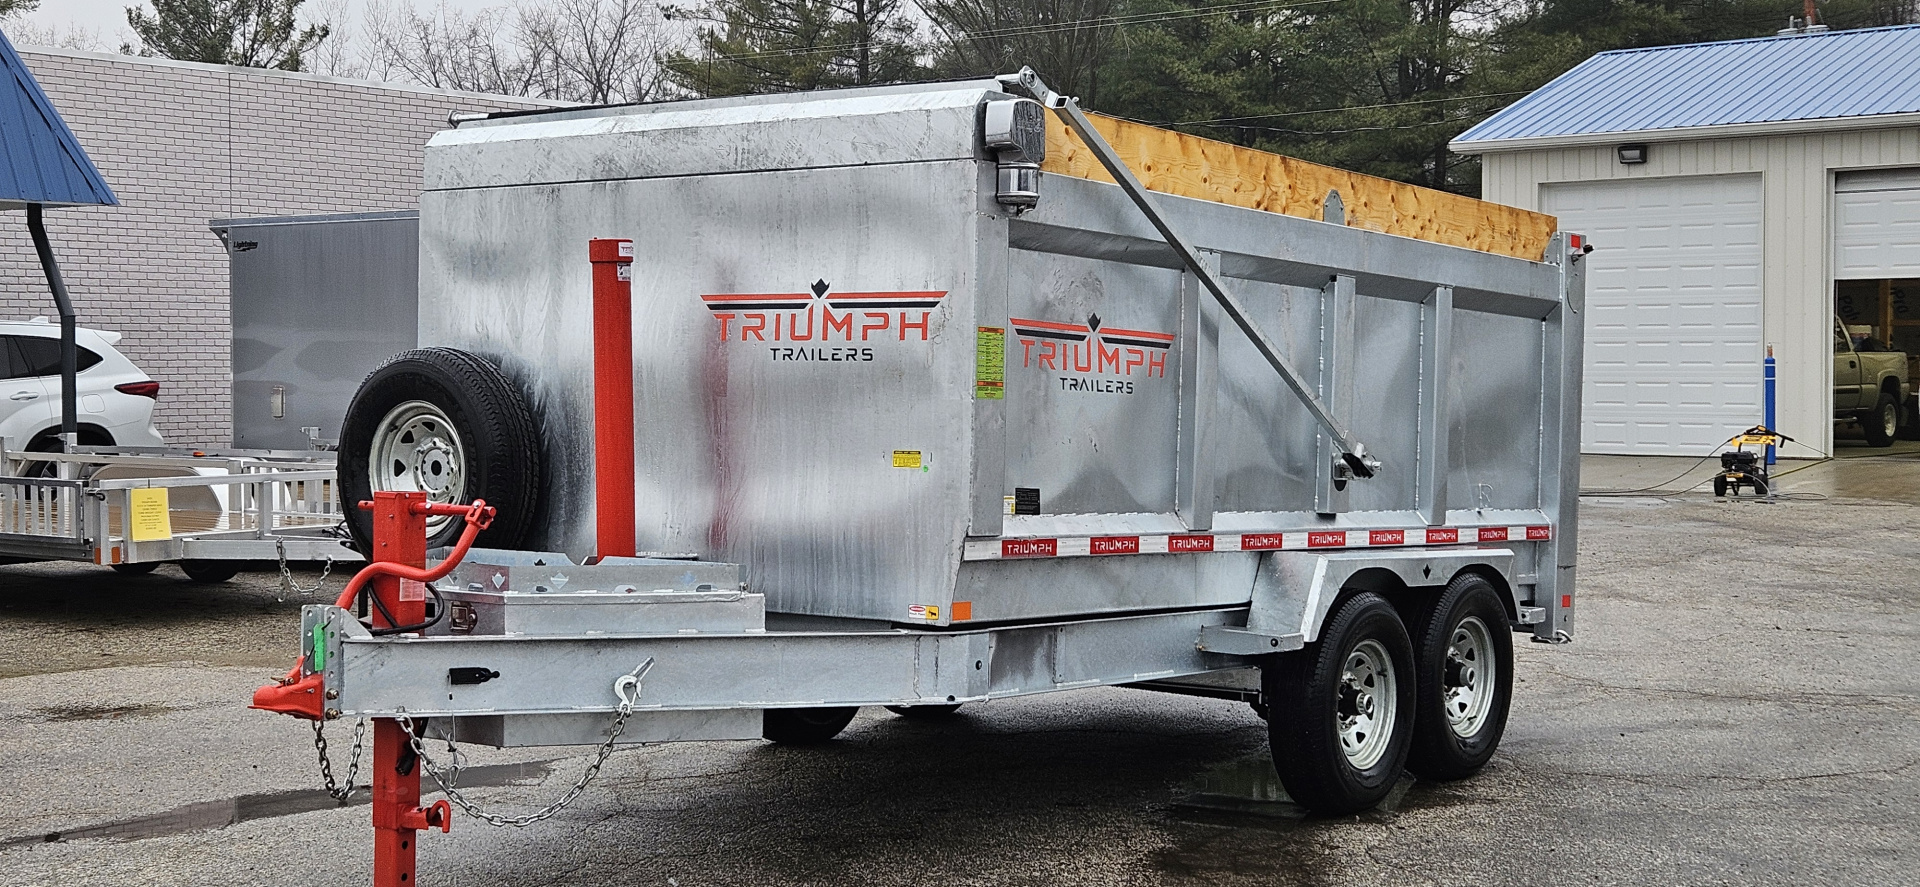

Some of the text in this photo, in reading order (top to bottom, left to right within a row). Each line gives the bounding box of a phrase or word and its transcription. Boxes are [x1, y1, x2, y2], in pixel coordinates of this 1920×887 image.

[713, 303, 931, 341] TRIUMPH
[770, 346, 873, 362] TRAILERS
[1019, 337, 1167, 378] TRIUMPH
[1060, 377, 1134, 394] TRAILERS
[1007, 543, 1052, 554] TRIUMPH
[1095, 539, 1135, 551] TRIUMPH
[1172, 538, 1210, 549] TRIUMPH
[1245, 536, 1279, 547] TRIUMPH
[1311, 534, 1343, 544] TRIUMPH
[1372, 532, 1402, 542] TRIUMPH
[1429, 531, 1456, 540] TRIUMPH
[1480, 530, 1506, 539] TRIUMPH
